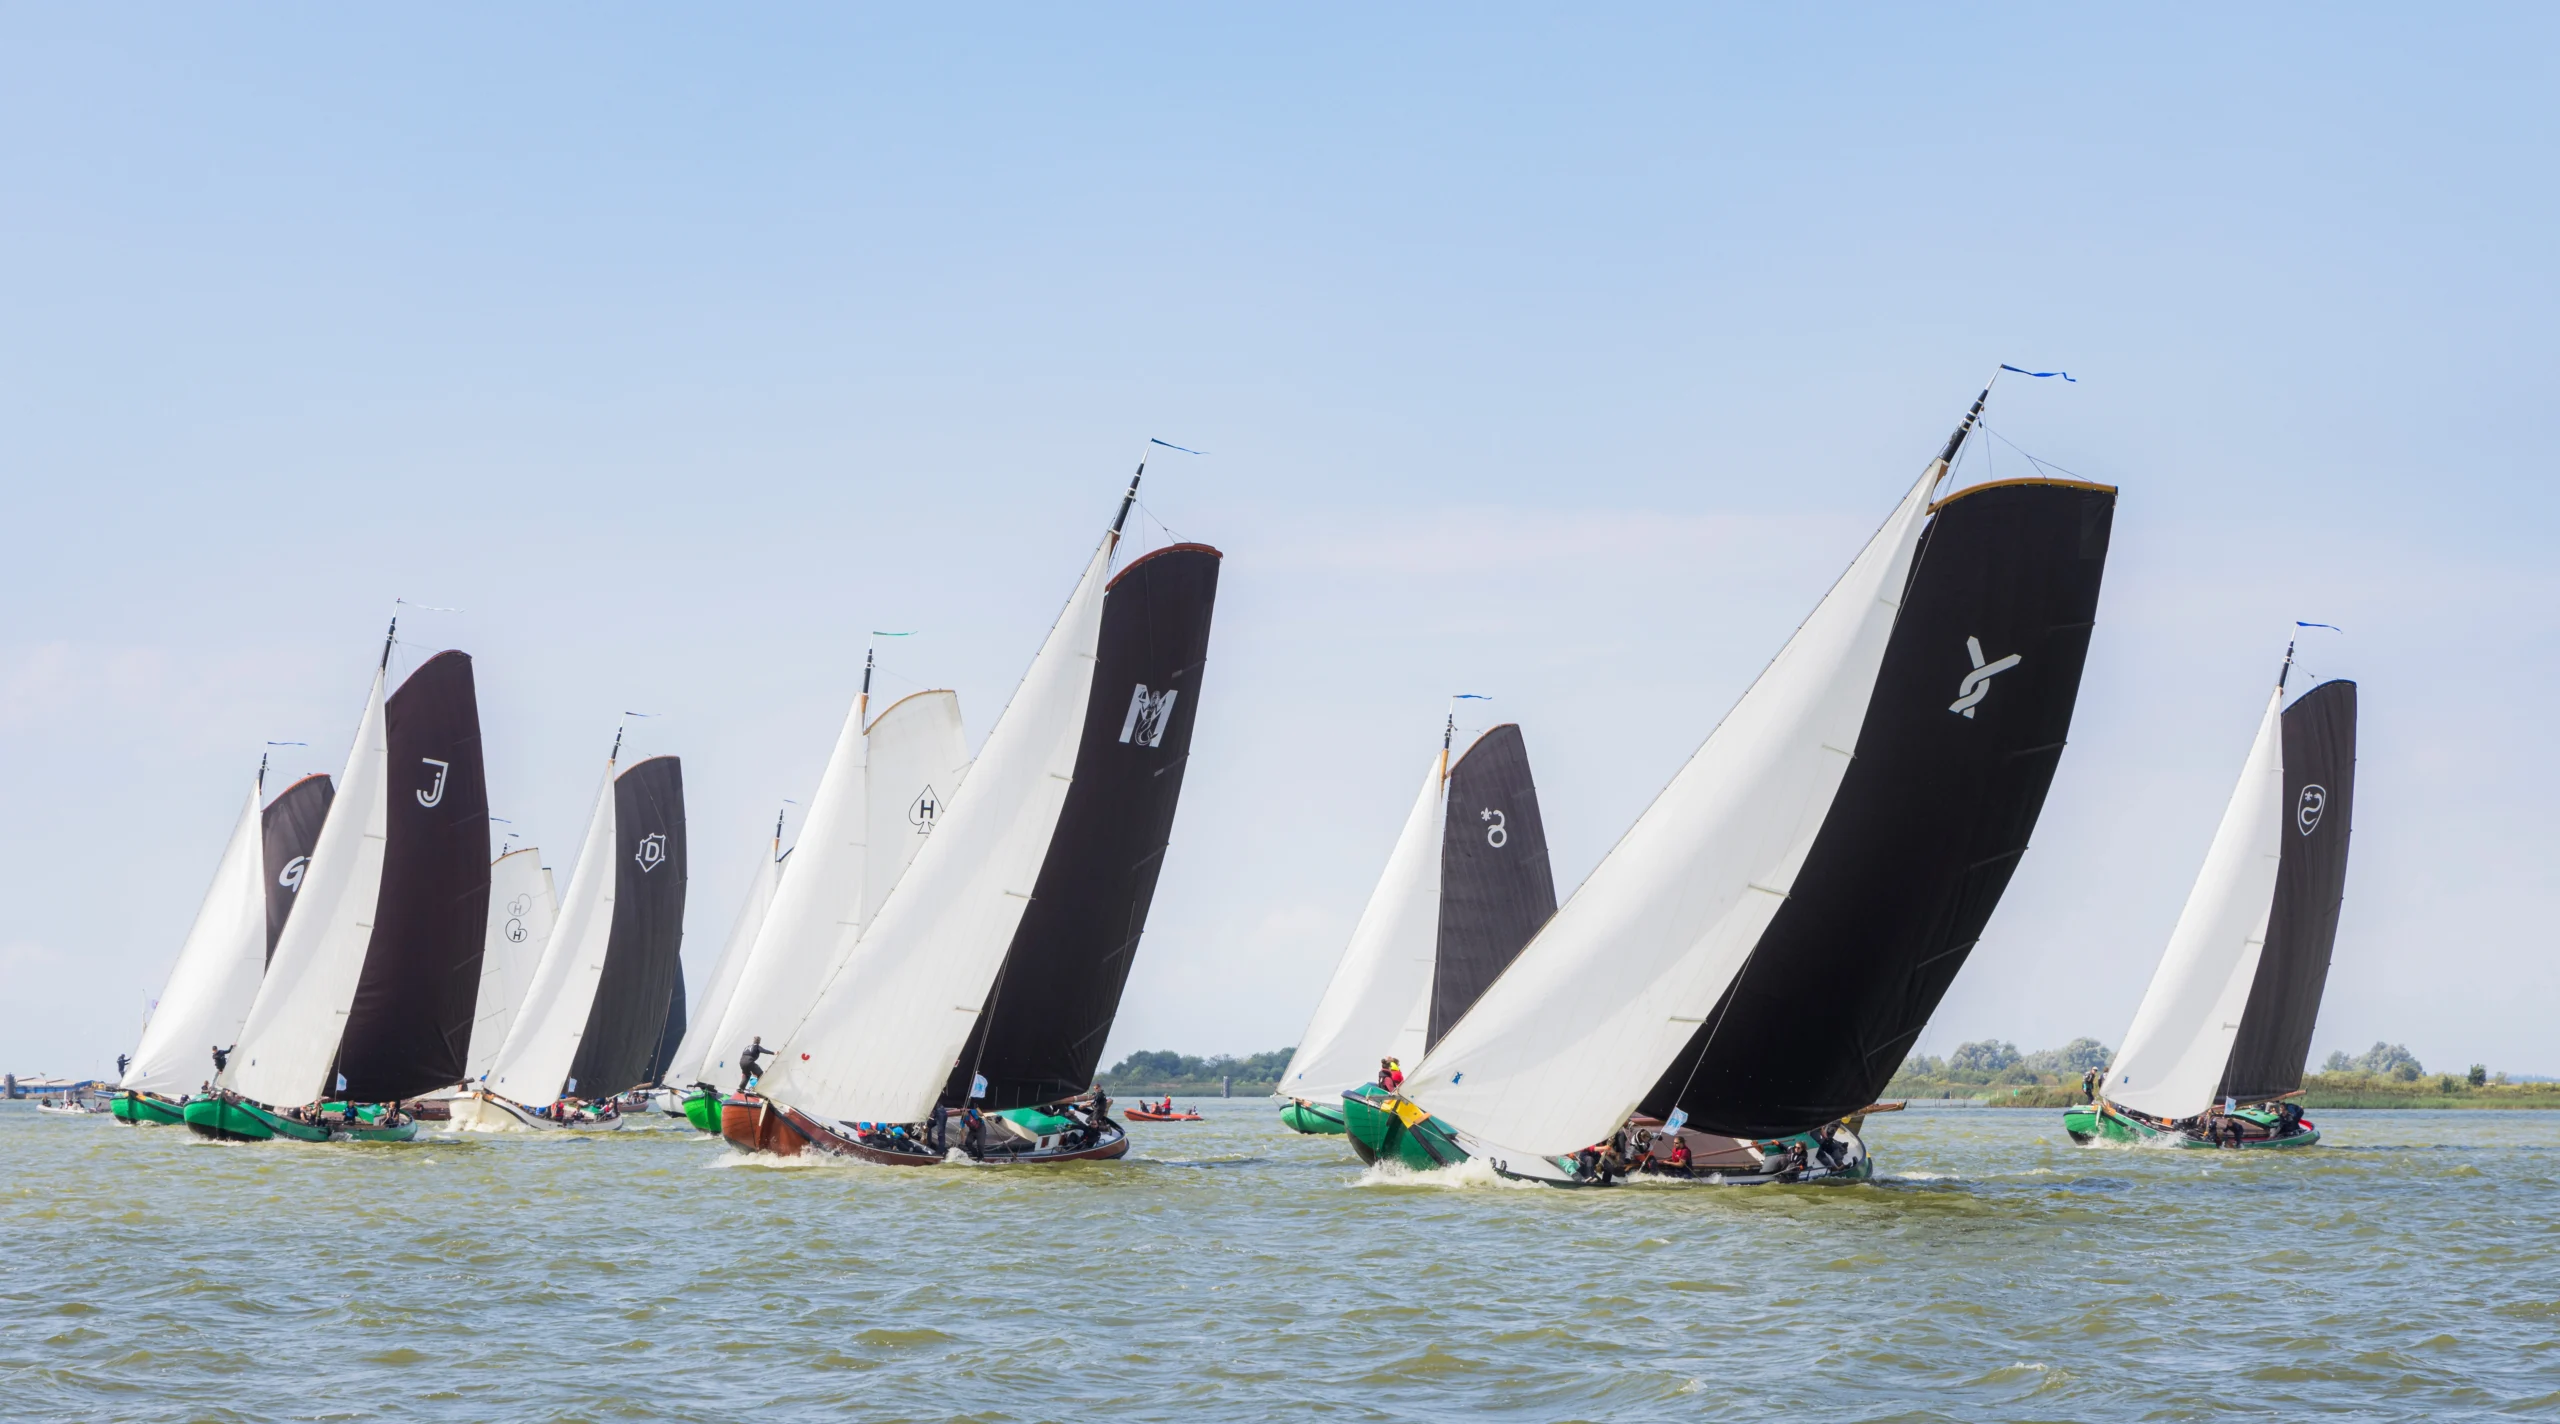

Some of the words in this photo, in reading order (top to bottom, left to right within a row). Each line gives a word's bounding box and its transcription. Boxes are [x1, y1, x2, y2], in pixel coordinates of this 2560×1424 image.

[1119, 683, 1178, 748] M
[920, 799, 935, 819] H
[645, 841, 660, 861] D
[513, 930, 522, 940] H
